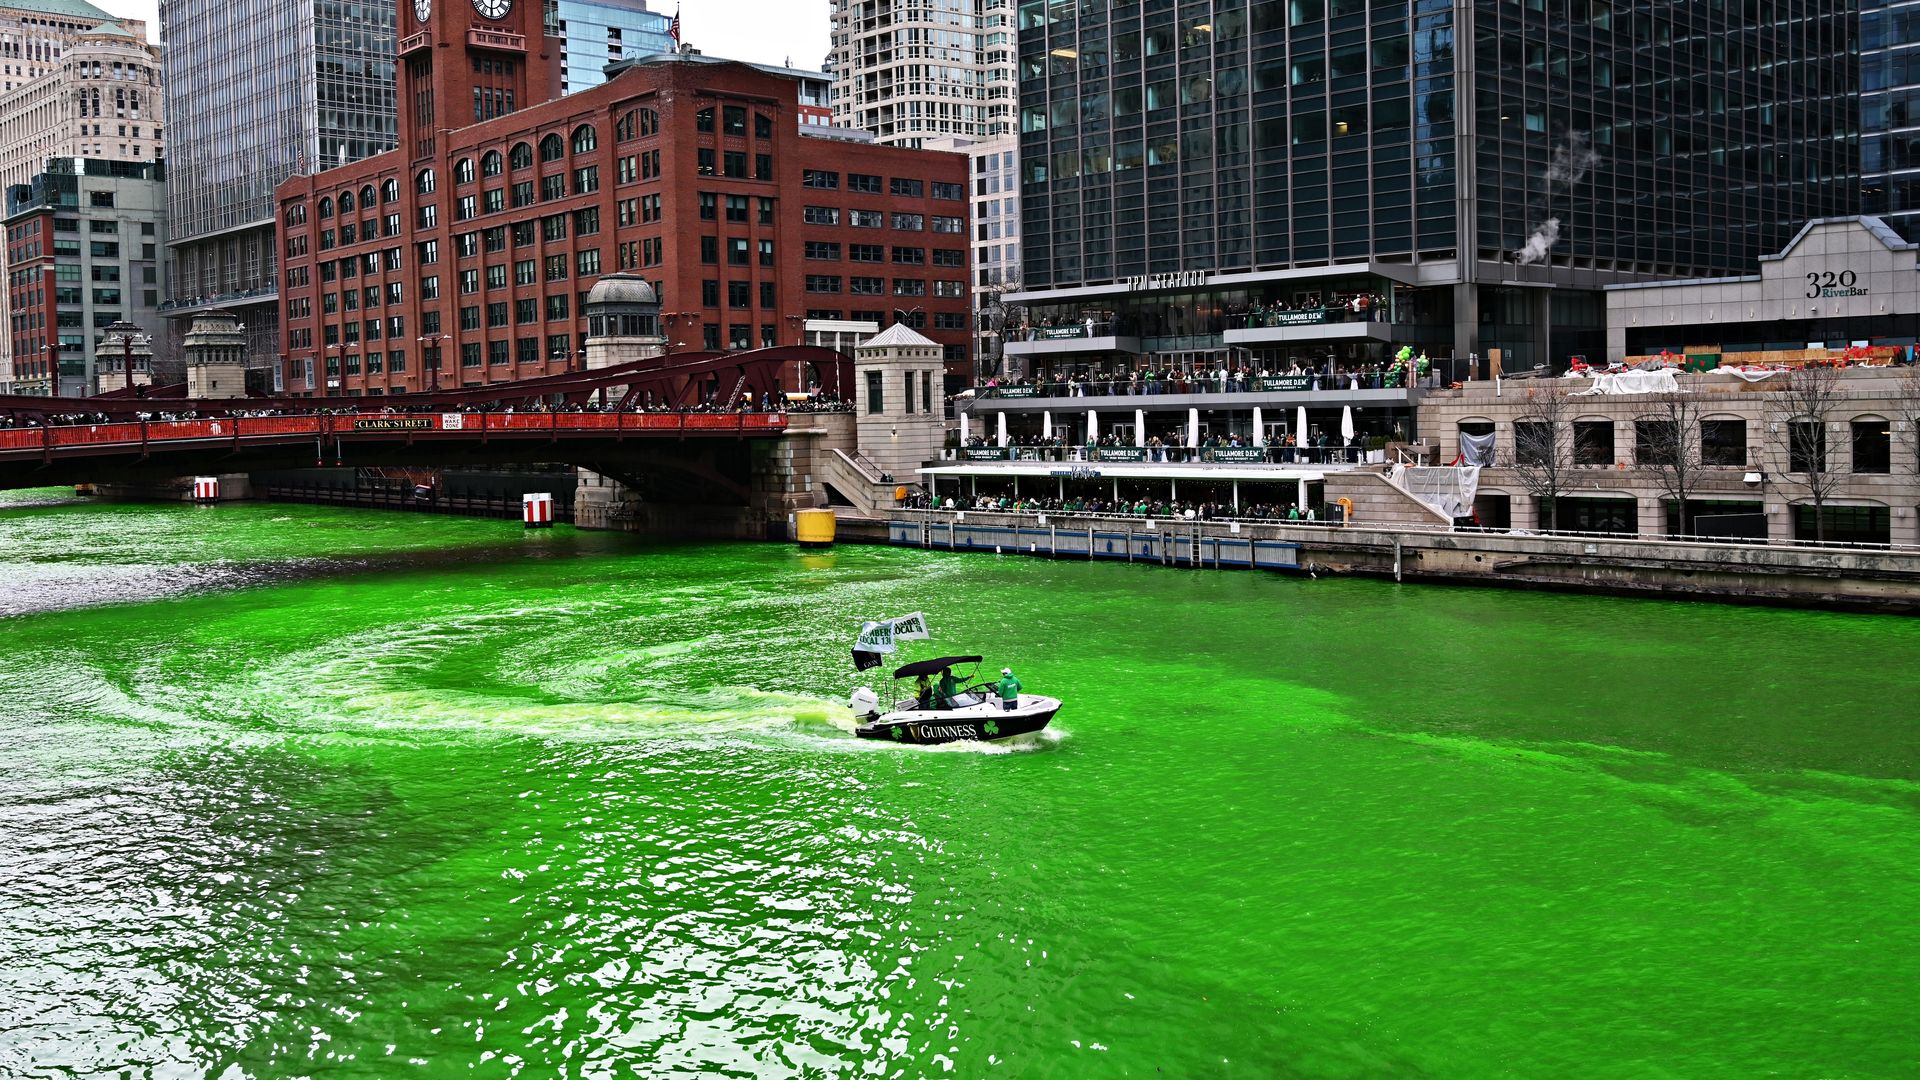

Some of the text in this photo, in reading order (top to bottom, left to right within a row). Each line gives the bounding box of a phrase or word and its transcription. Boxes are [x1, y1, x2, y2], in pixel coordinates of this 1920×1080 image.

[1127, 270, 1205, 291] RPM SEAFOOD
[1806, 270, 1857, 299] 320
[1822, 287, 1868, 298] RiverBar
[1278, 313, 1308, 321] TULLAMORE
[1263, 379, 1292, 387] TULLAMORE
[358, 419, 428, 428] CLARK STREET
[1100, 449, 1127, 457] TULLAMORE
[920, 724, 977, 738] GUINNESS
